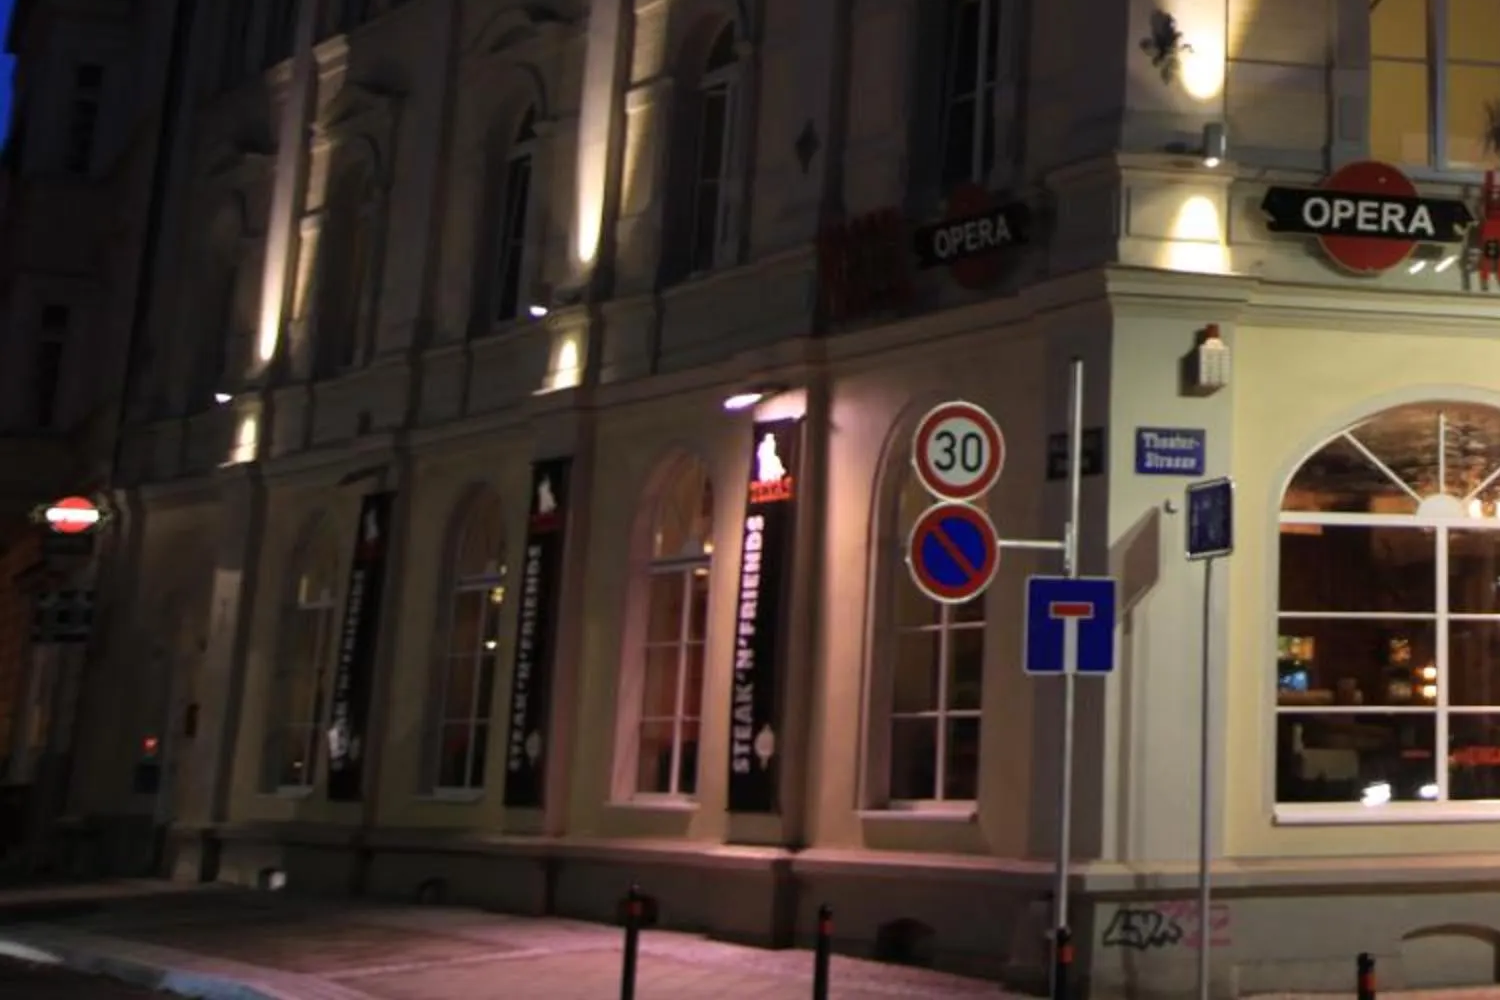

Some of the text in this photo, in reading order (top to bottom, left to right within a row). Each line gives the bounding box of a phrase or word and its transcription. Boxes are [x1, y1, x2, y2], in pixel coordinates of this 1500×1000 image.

[933, 214, 1012, 259] OPERA
[1303, 196, 1435, 236] OPERA
[934, 430, 983, 473] 30
